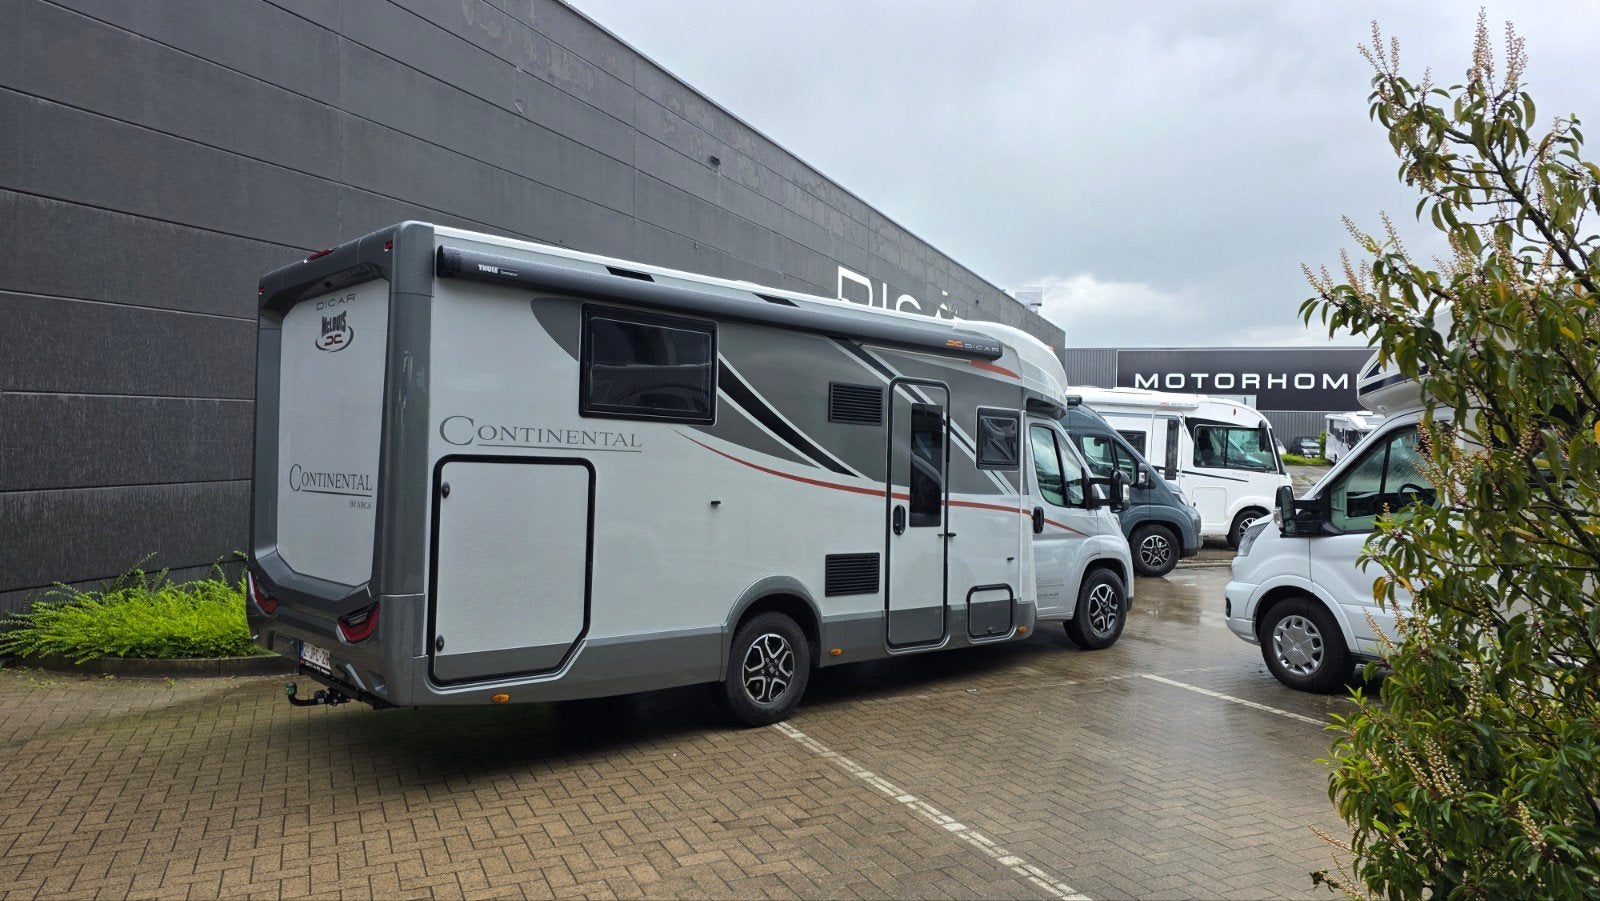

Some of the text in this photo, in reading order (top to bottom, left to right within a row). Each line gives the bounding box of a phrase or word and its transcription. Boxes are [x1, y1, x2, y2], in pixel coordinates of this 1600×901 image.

[478, 263, 498, 273] THULE
[316, 293, 356, 311] DICAR
[964, 343, 999, 353] DICAR
[1134, 373, 1361, 390] MOTORHOM
